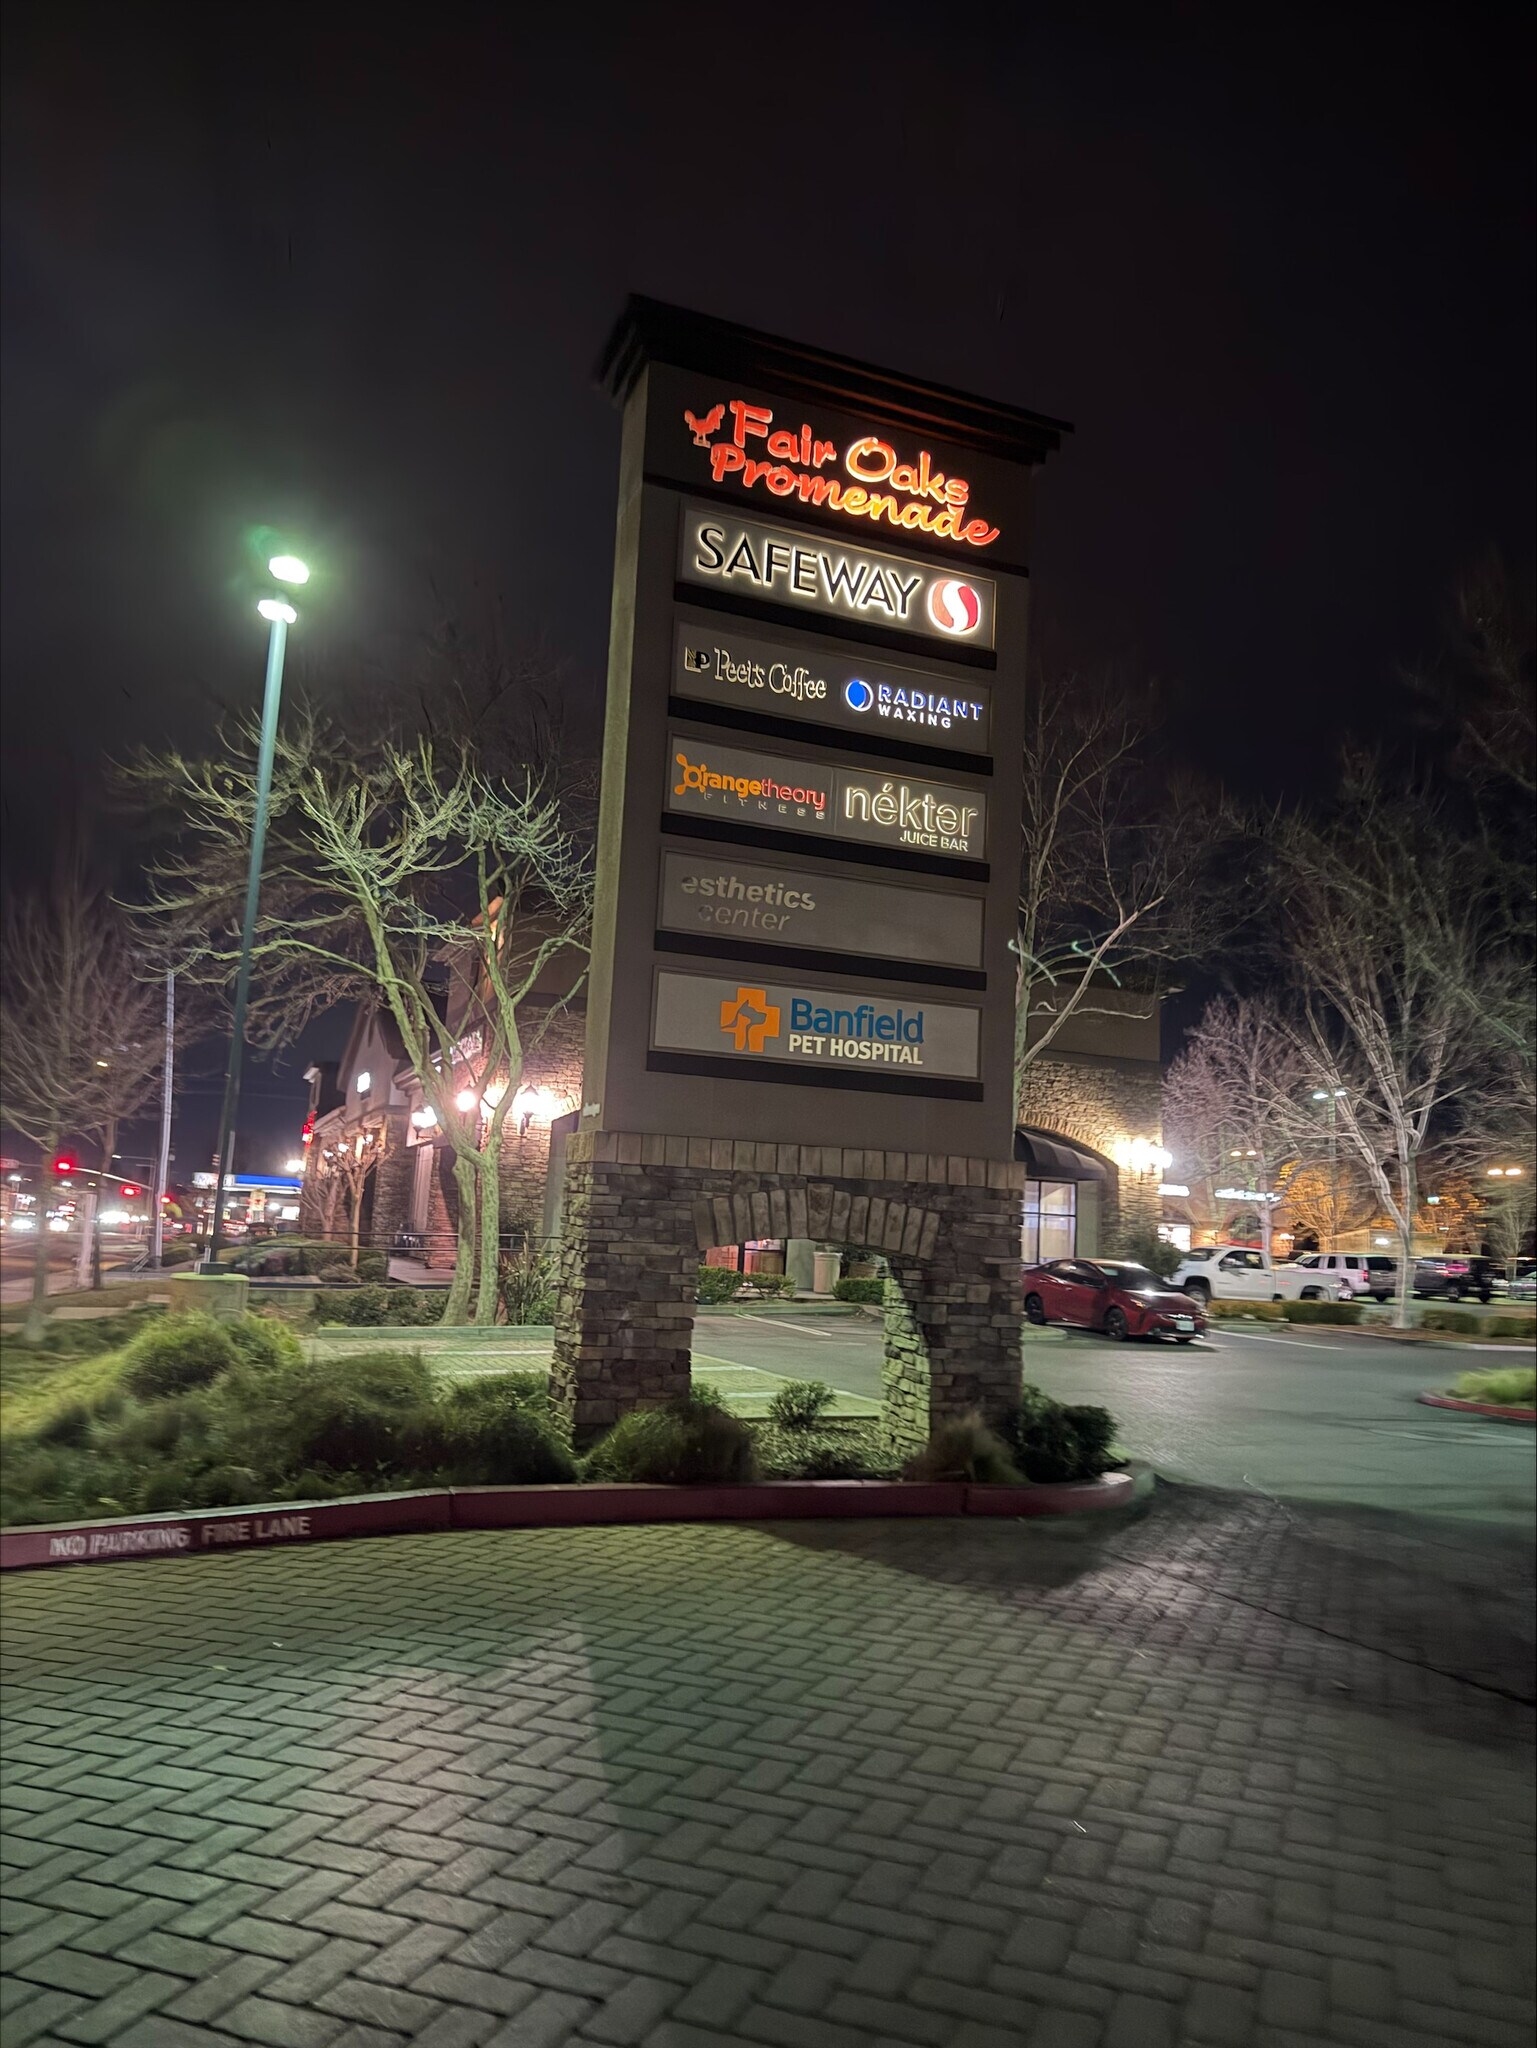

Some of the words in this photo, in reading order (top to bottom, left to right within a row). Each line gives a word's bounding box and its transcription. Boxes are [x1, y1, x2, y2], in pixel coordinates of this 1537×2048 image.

[730, 400, 837, 468] Fair
[846, 437, 970, 507] Oaks
[710, 443, 1001, 546] Promenade
[697, 523, 922, 619] SAFEWAY
[768, 663, 828, 701] Coffee
[877, 684, 983, 721] RADIANT
[877, 703, 952, 729] WAXING
[899, 830, 939, 847] JUICE
[940, 836, 969, 852] BAR
[681, 876, 816, 911] esthetics
[698, 904, 791, 931] center
[790, 997, 924, 1044] Banfield
[789, 1033, 826, 1056] PET
[830, 1038, 923, 1065] HOSPITAL
[50, 1535, 86, 1556] NO
[90, 1527, 190, 1554] PARKING
[202, 1521, 250, 1544] FIRE
[255, 1516, 312, 1538] LANE
